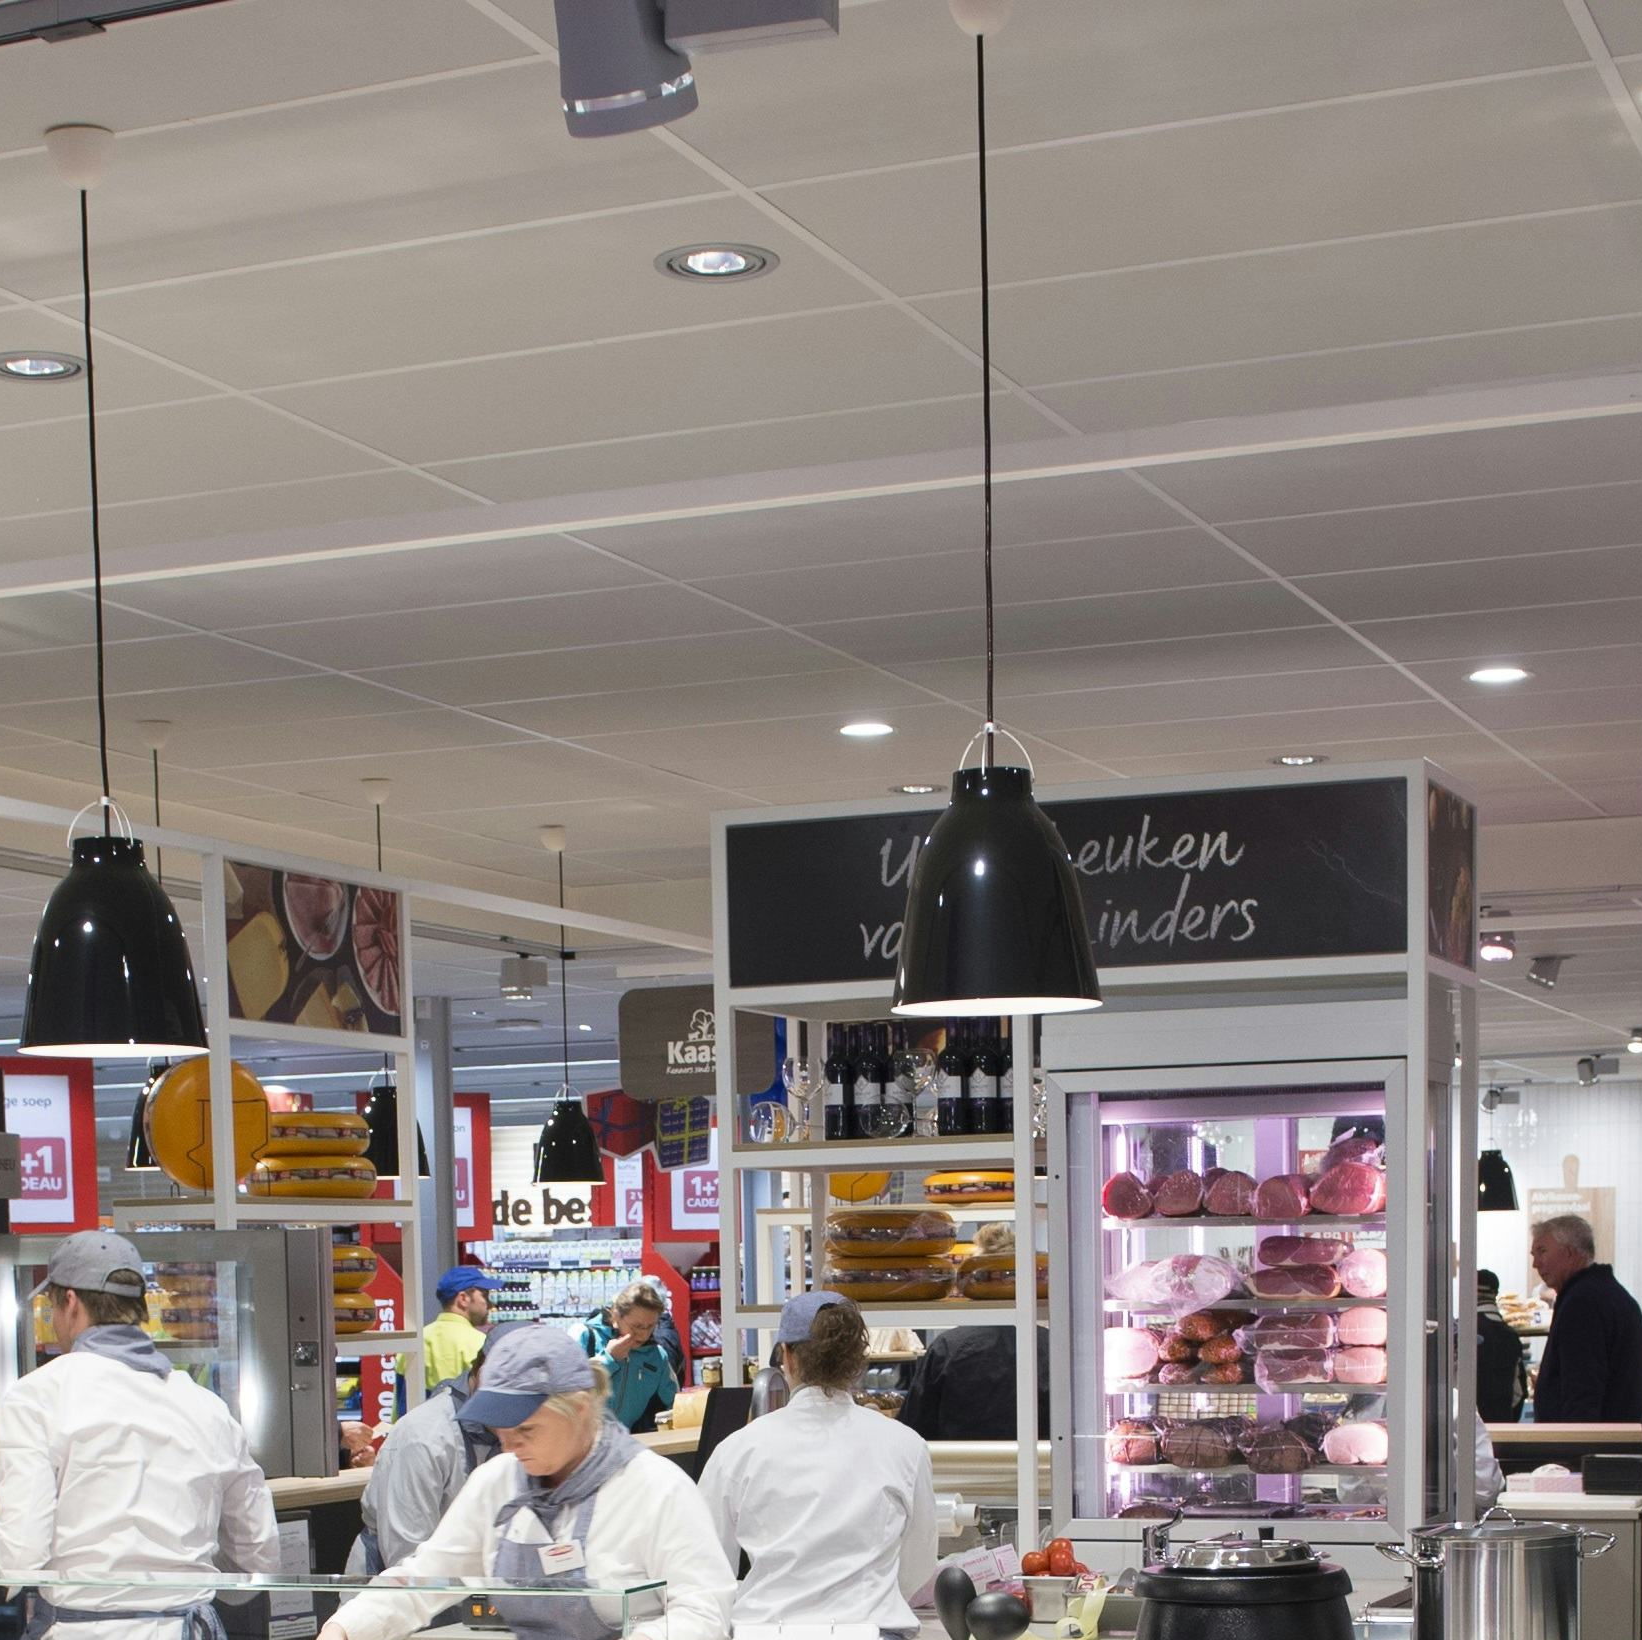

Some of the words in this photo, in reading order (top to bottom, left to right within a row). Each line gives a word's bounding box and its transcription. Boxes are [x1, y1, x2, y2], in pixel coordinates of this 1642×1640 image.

[1070, 814, 1245, 876] euken
[1090, 873, 1258, 948] inders
[22, 1098, 52, 1109] soep
[21, 1176, 62, 1191] DEAU
[492, 1190, 532, 1225] de
